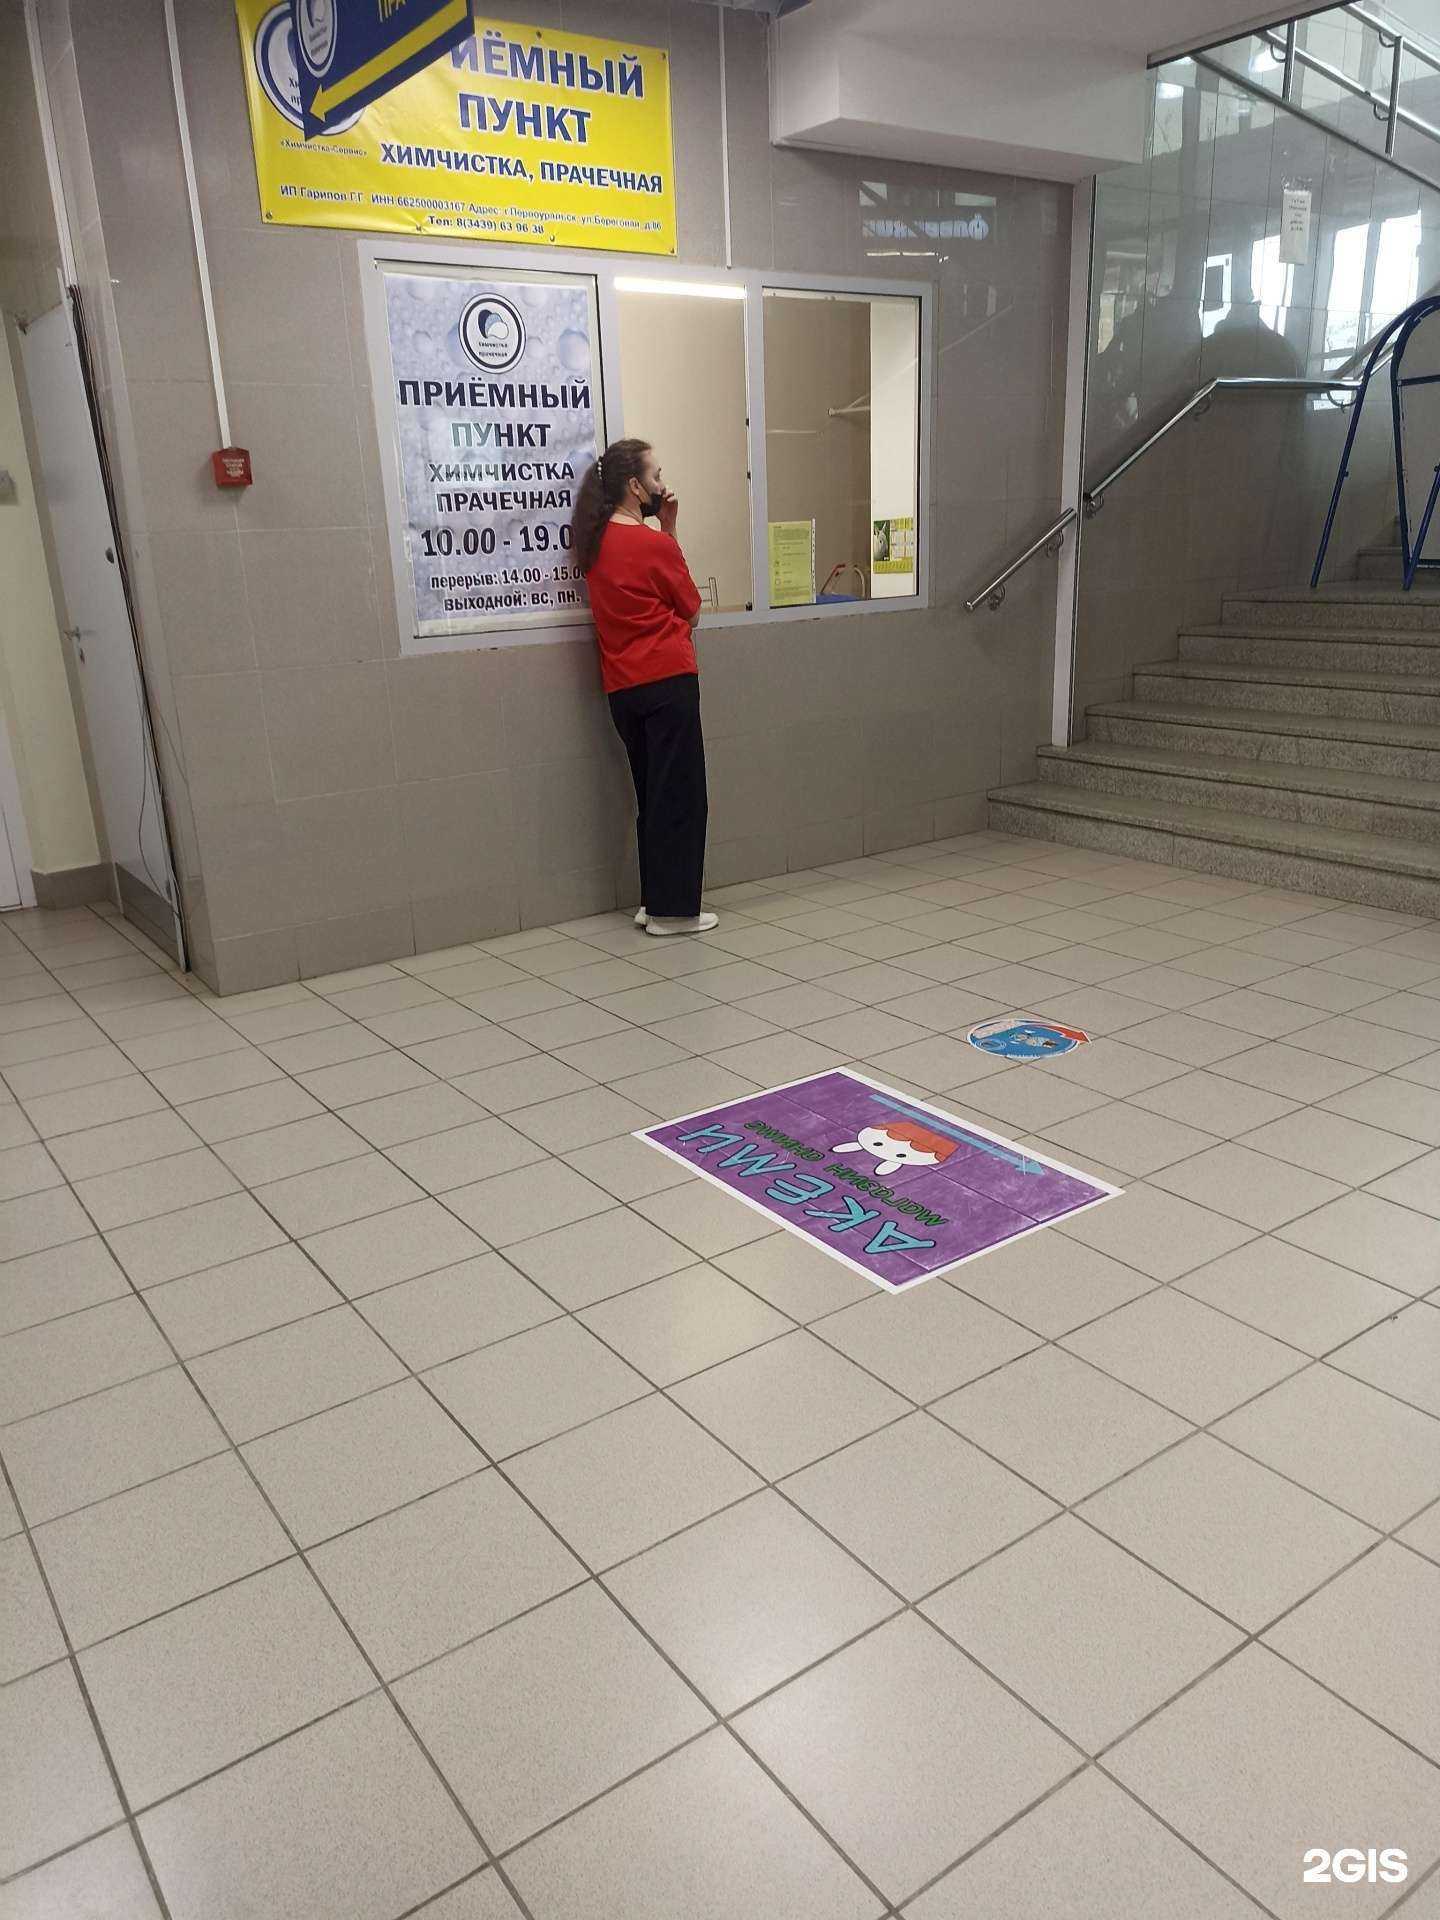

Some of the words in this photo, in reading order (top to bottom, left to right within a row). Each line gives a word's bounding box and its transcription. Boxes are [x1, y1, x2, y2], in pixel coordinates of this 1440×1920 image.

[450, 29, 645, 98] ИЁМНЫЙ
[459, 92, 591, 143] ПУНКТ
[380, 143, 533, 181] ХИМЧИСТКА,
[541, 161, 663, 193] ПРАЧЕЧНАЯ
[280, 185, 297, 196] ИП
[371, 194, 394, 205] ИНН
[398, 377, 591, 409] ПРИЁМНЫЙ
[451, 422, 551, 447] ПУНКТ
[429, 463, 575, 483] ХИМЧИСТКА
[436, 489, 572, 512] ПРАЧЕЧНАЯ
[421, 527, 496, 557] 10.00
[519, 524, 574, 552] 19.0
[431, 574, 498, 591] перерыв:
[501, 567, 541, 584] 14.00
[444, 590, 527, 612] выходной:
[531, 592, 554, 607] вс,
[557, 589, 581, 603] пн.
[677, 1123, 937, 1255] АКЕМИ
